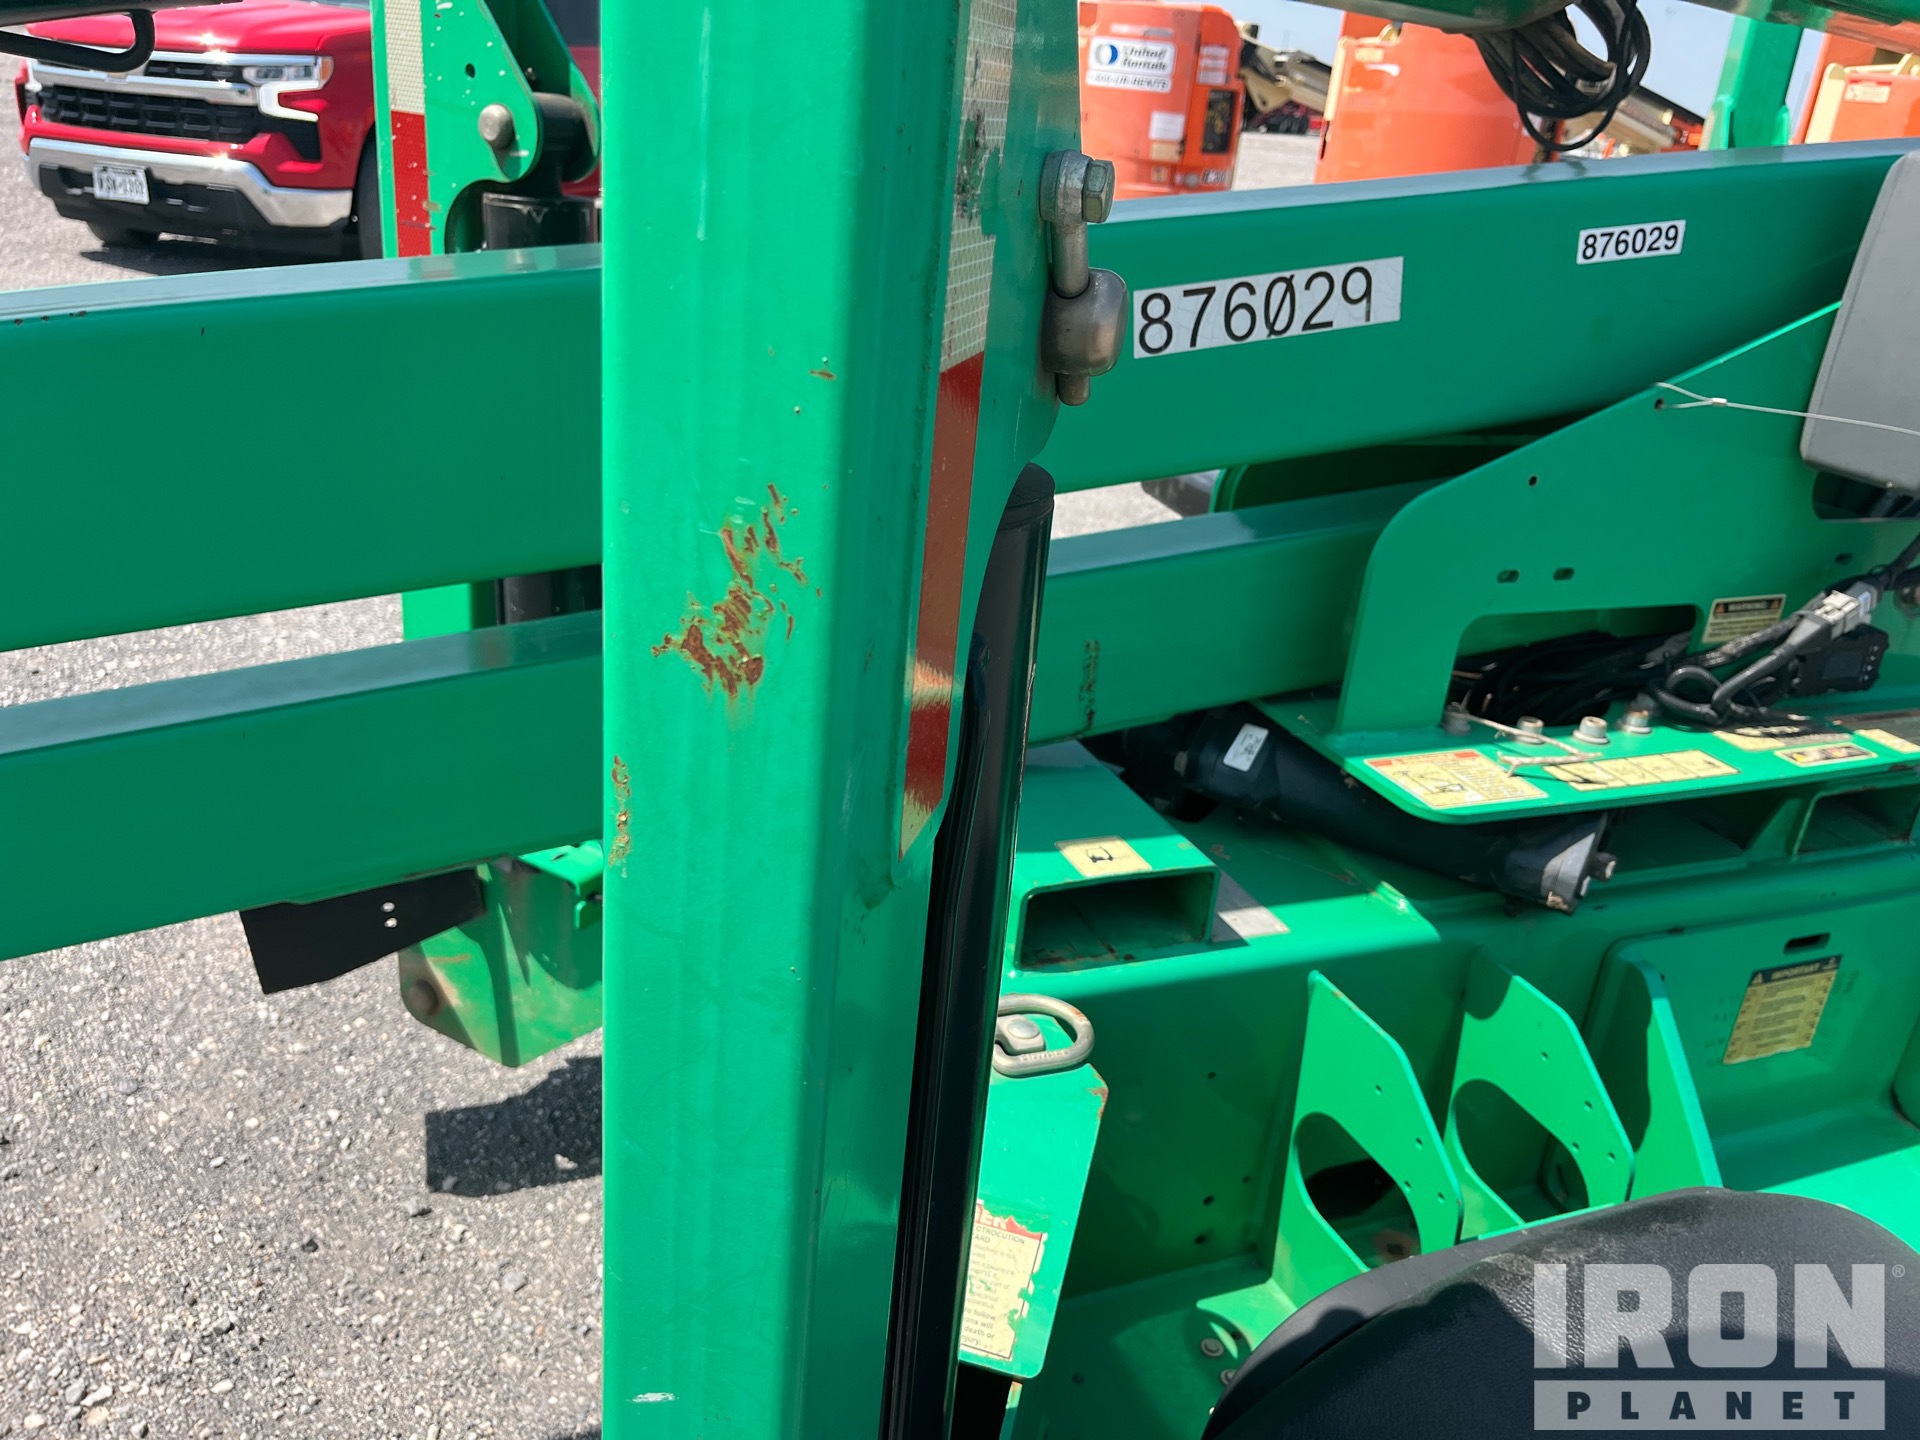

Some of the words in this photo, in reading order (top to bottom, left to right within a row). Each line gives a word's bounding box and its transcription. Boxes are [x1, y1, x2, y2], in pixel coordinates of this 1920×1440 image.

[1582, 225, 1678, 260] 876029
[973, 1234, 991, 1243] ARD
[975, 1226, 1025, 1244] CTROCUTION
[961, 1334, 981, 1345] njury.
